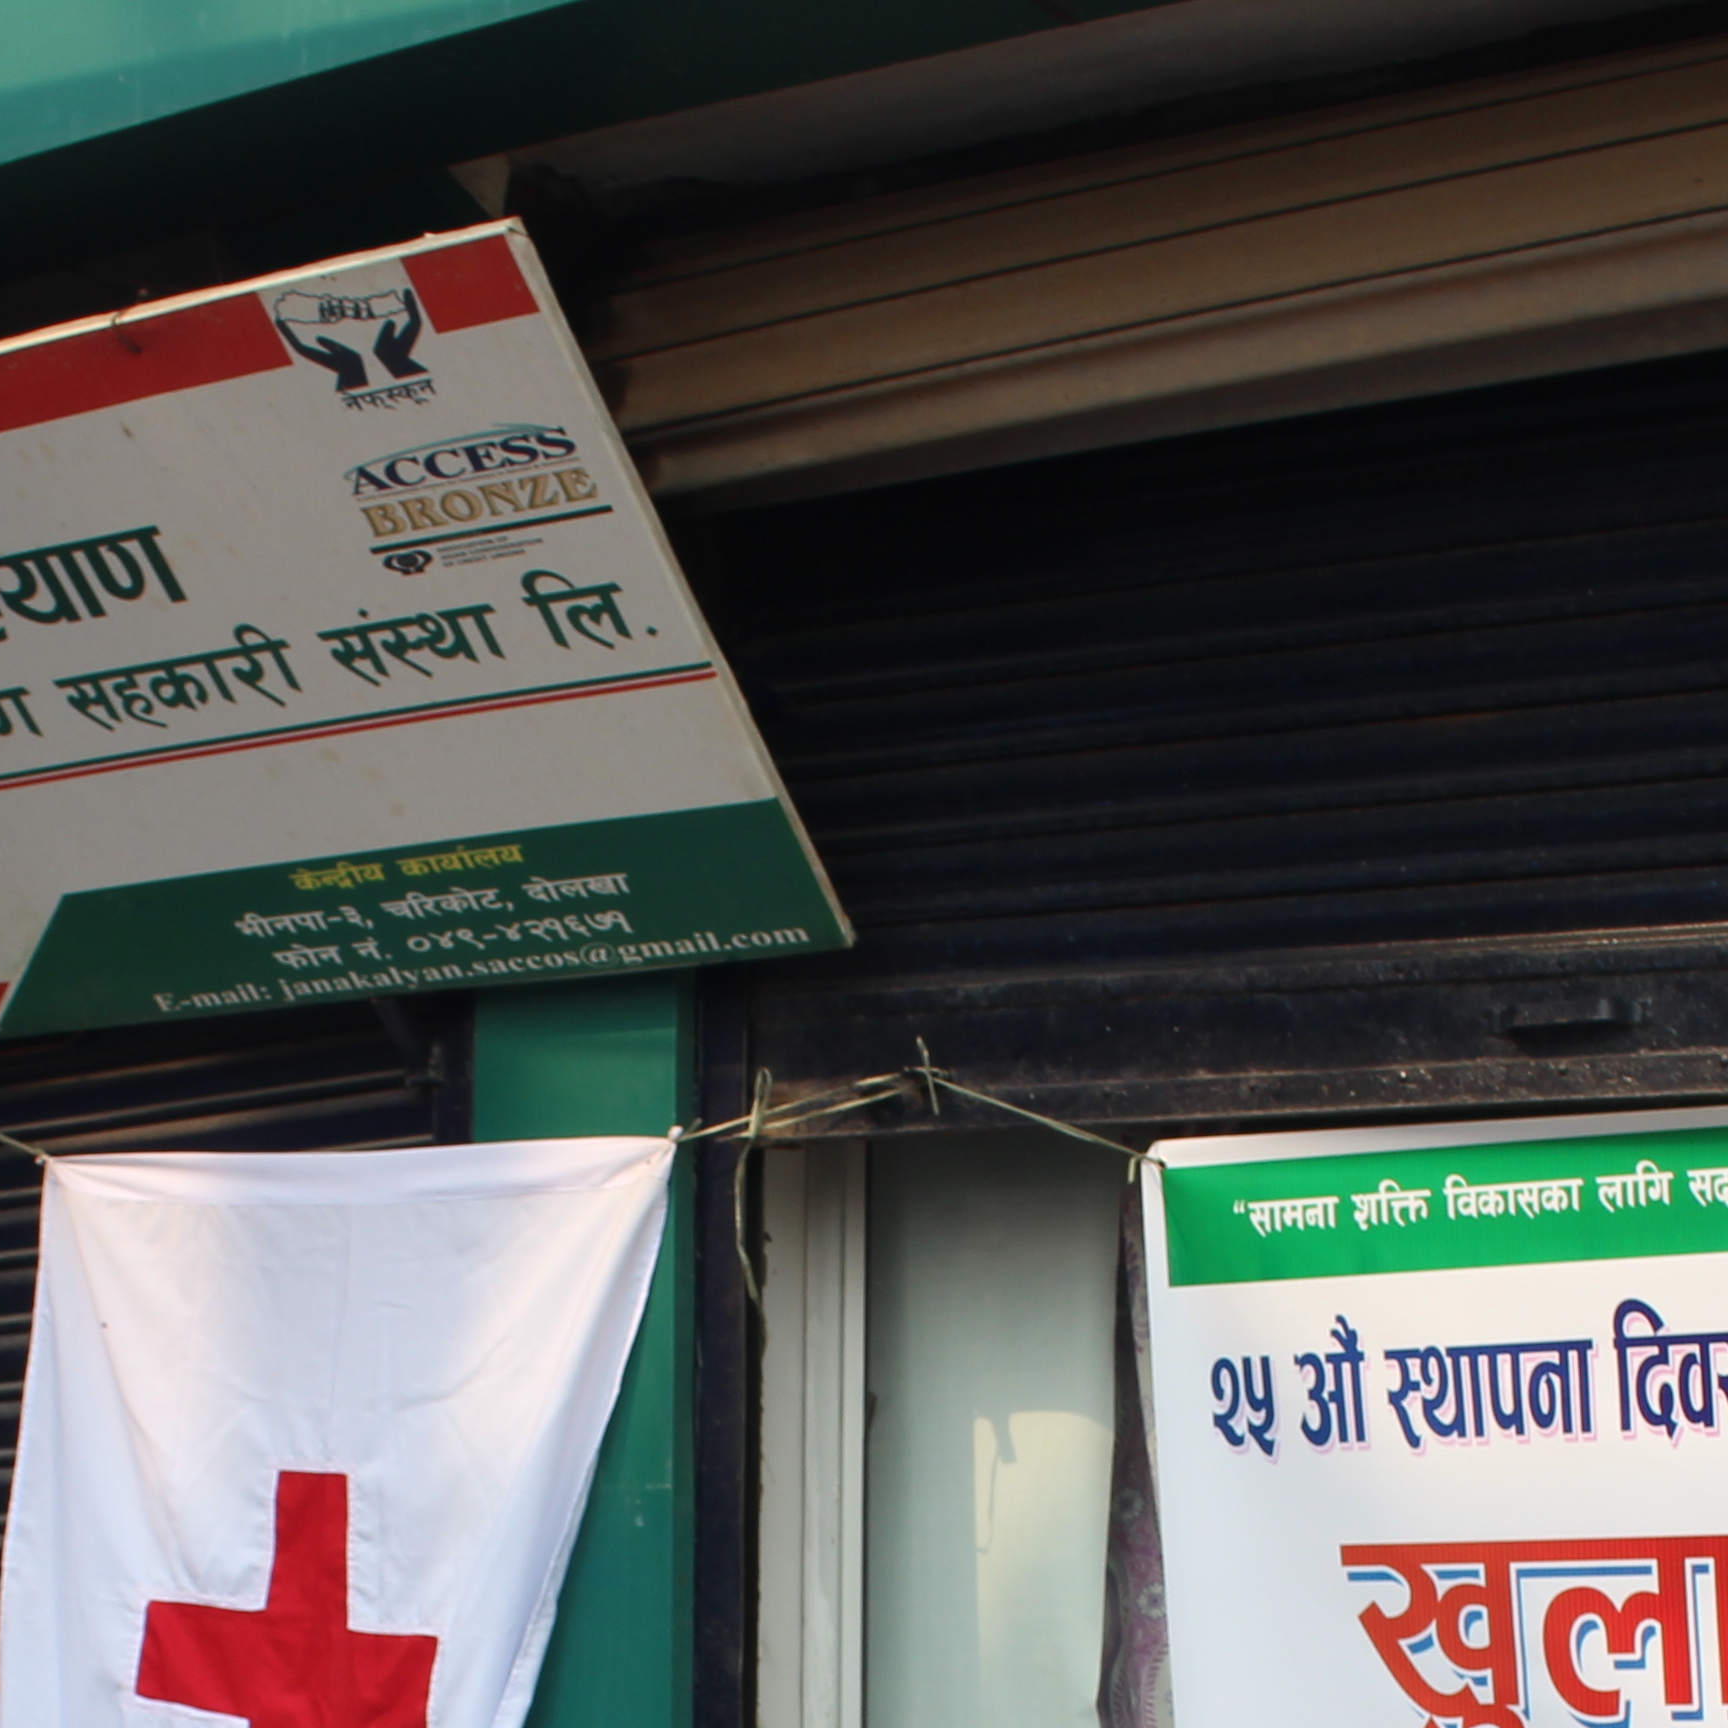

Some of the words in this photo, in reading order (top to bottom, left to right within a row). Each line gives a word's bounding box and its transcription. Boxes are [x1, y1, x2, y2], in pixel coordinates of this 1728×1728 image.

[350, 427, 578, 496] ACCESS
[361, 467, 598, 538] BRONZE
[54, 623, 304, 732] सहकारी
[317, 607, 506, 687] संस्था
[521, 569, 658, 650] लि.
[289, 861, 387, 891] केन्द्रीय
[396, 843, 524, 877] कार्यालय
[379, 886, 515, 921] चरिकोट,
[521, 872, 631, 901] दोलखा
[152, 982, 272, 1013] E-mail:
[276, 923, 811, 1002] janakalyan.saccos@gmail.com
[273, 943, 344, 970] फोन
[351, 936, 393, 962] नं.
[406, 910, 633, 952] ०४९-४२१६७१
[1351, 1178, 1432, 1231] शक्ति
[1443, 1173, 1584, 1220] विकासका
[1596, 1159, 1675, 1213] लागि
[1210, 1354, 1276, 1456] २५
[1384, 1337, 1594, 1450] स्थापना
